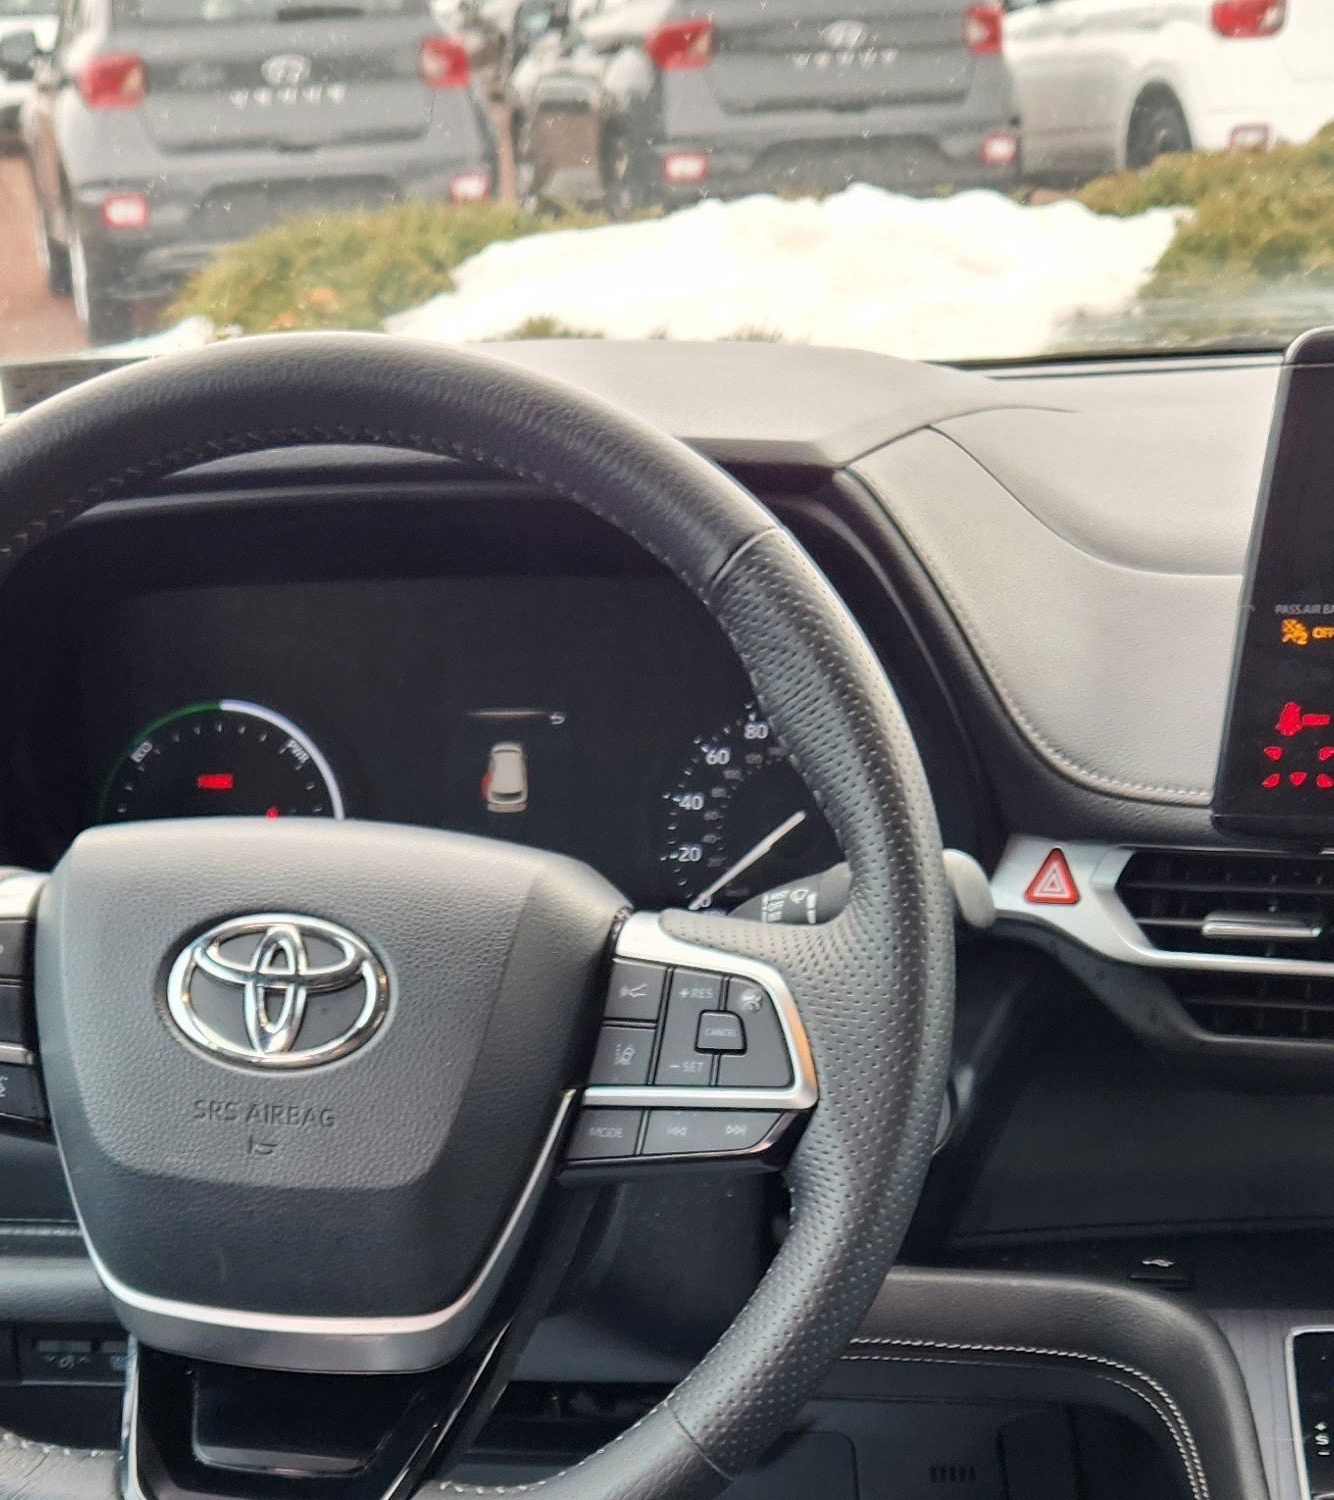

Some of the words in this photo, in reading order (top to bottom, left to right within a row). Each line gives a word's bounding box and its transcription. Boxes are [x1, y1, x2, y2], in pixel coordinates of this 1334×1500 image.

[744, 723, 769, 739] 80
[705, 750, 730, 765] 60
[679, 795, 704, 811] 40
[679, 847, 703, 862] 20
[193, 1100, 237, 1121] SRS
[245, 1102, 335, 1128] AIRBAG
